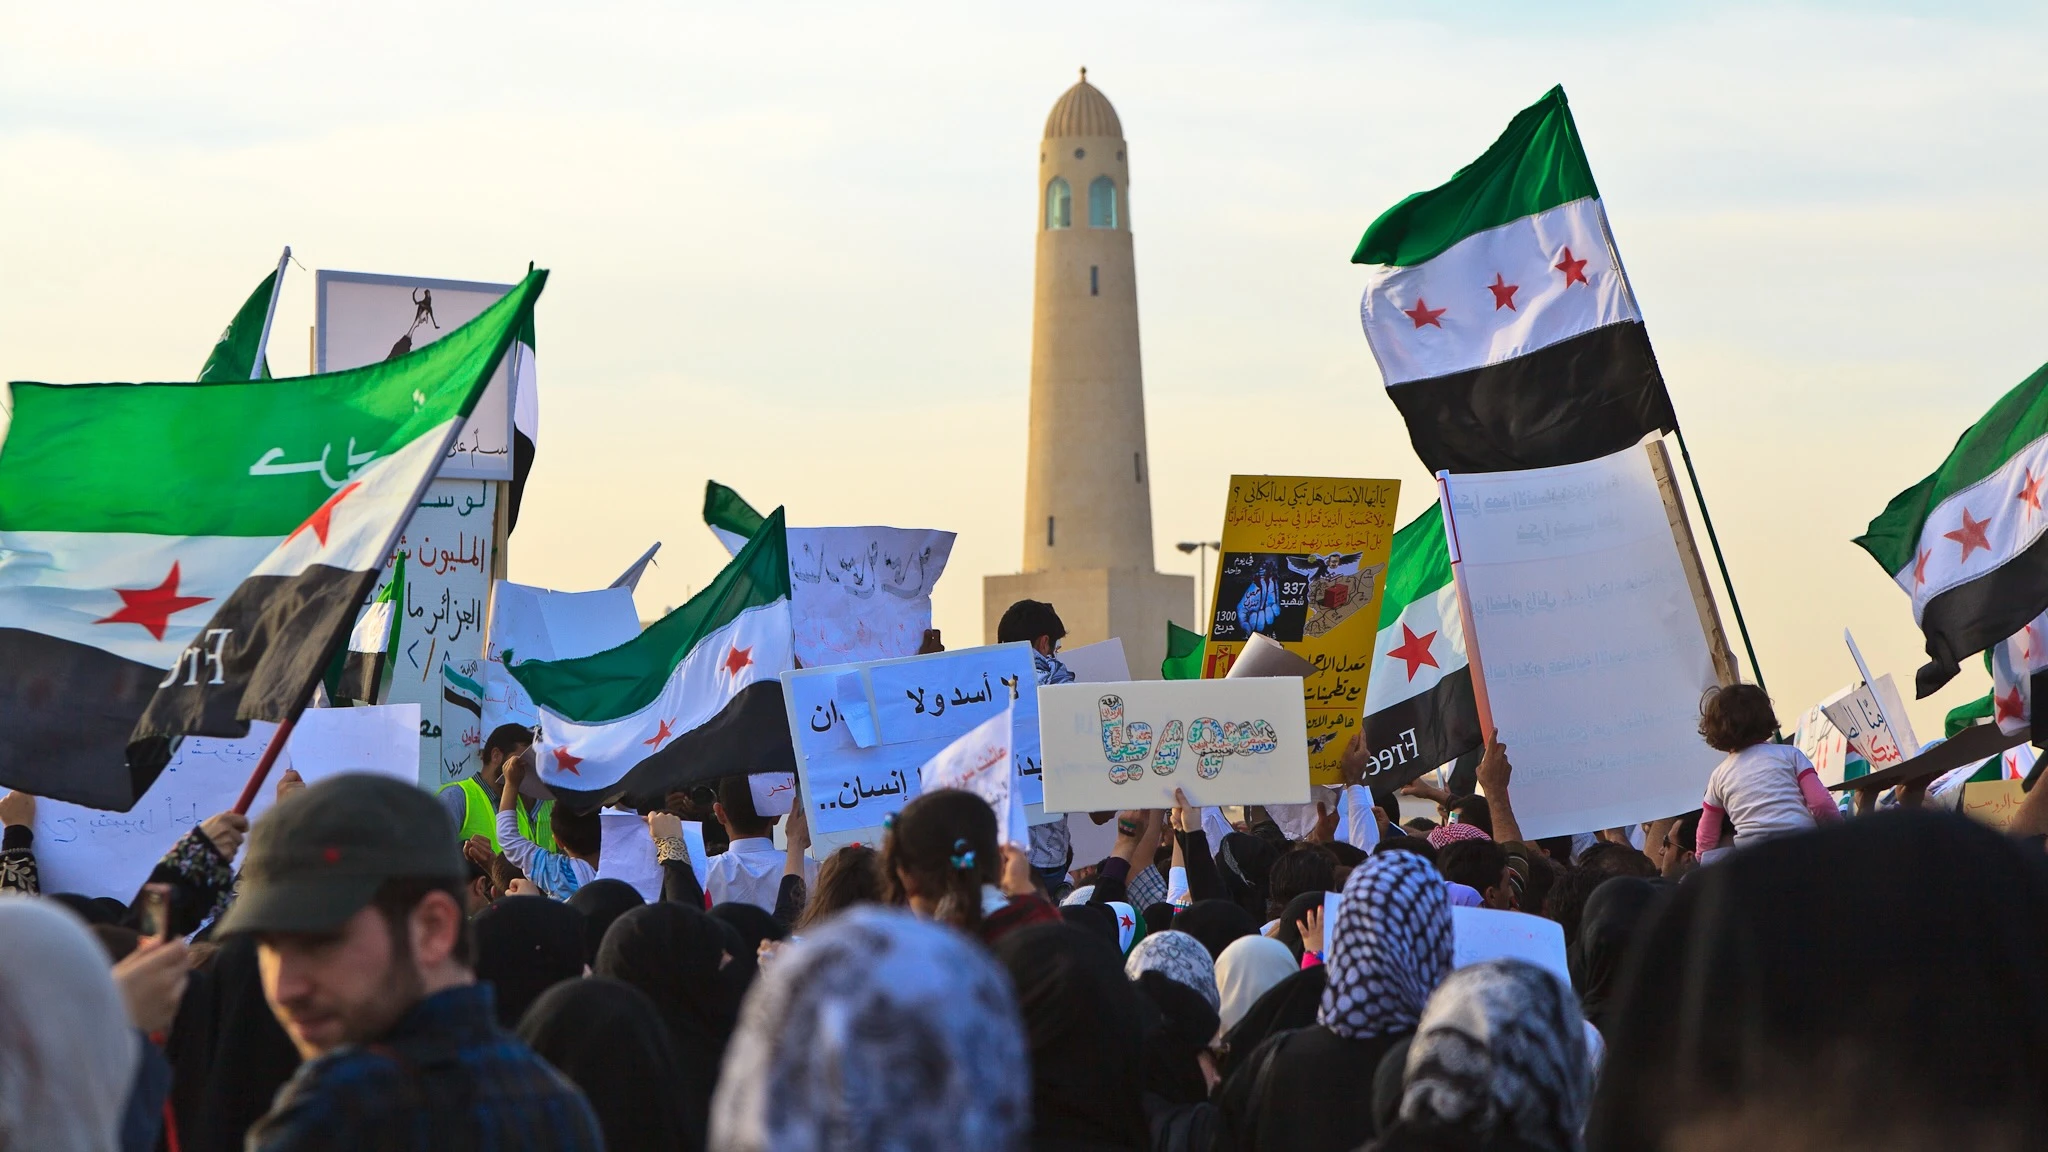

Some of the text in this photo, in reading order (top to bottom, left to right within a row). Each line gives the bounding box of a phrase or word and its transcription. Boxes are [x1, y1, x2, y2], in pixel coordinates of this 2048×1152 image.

[1282, 582, 1306, 595] 337
[1216, 611, 1237, 622] 1300
[951, 672, 992, 706] أسد
